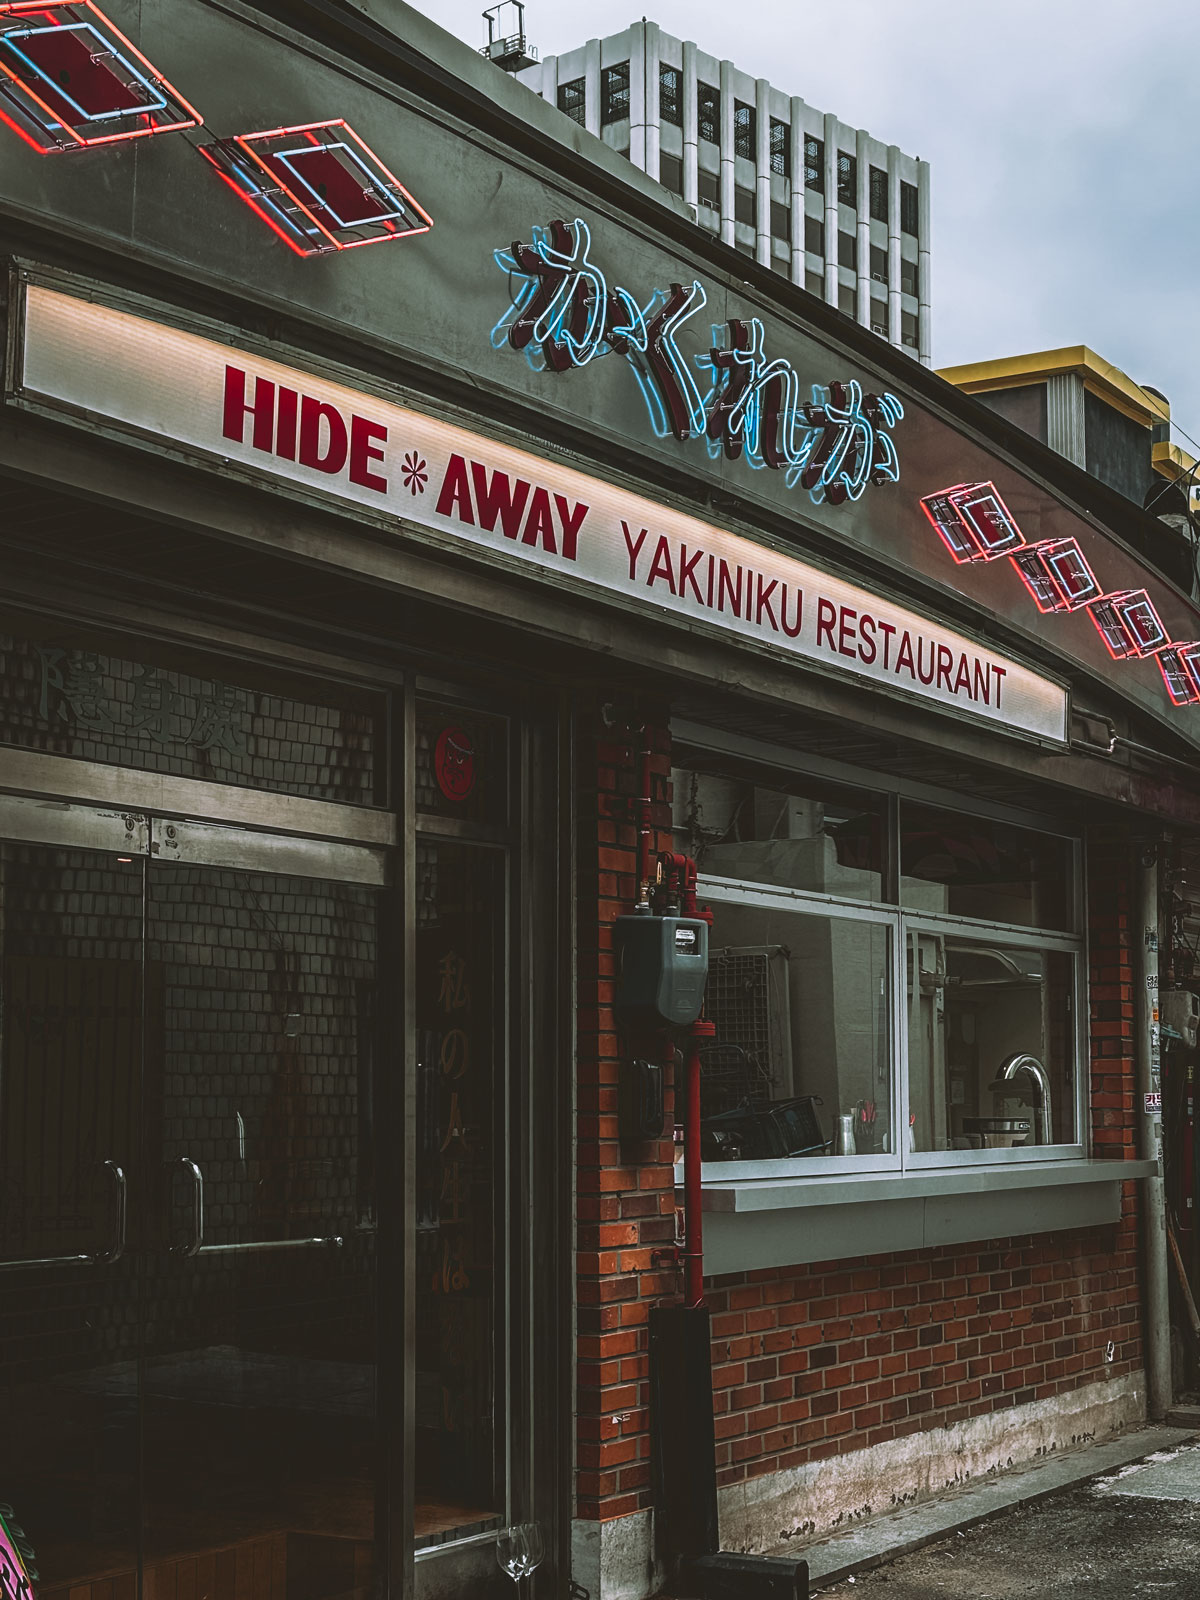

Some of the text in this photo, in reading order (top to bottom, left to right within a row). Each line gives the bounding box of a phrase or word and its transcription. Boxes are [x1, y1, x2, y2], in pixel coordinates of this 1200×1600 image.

[492, 218, 904, 505] かくれが
[222, 364, 1007, 710] HIDE AWAY YAKINIKU RESTAURANT
